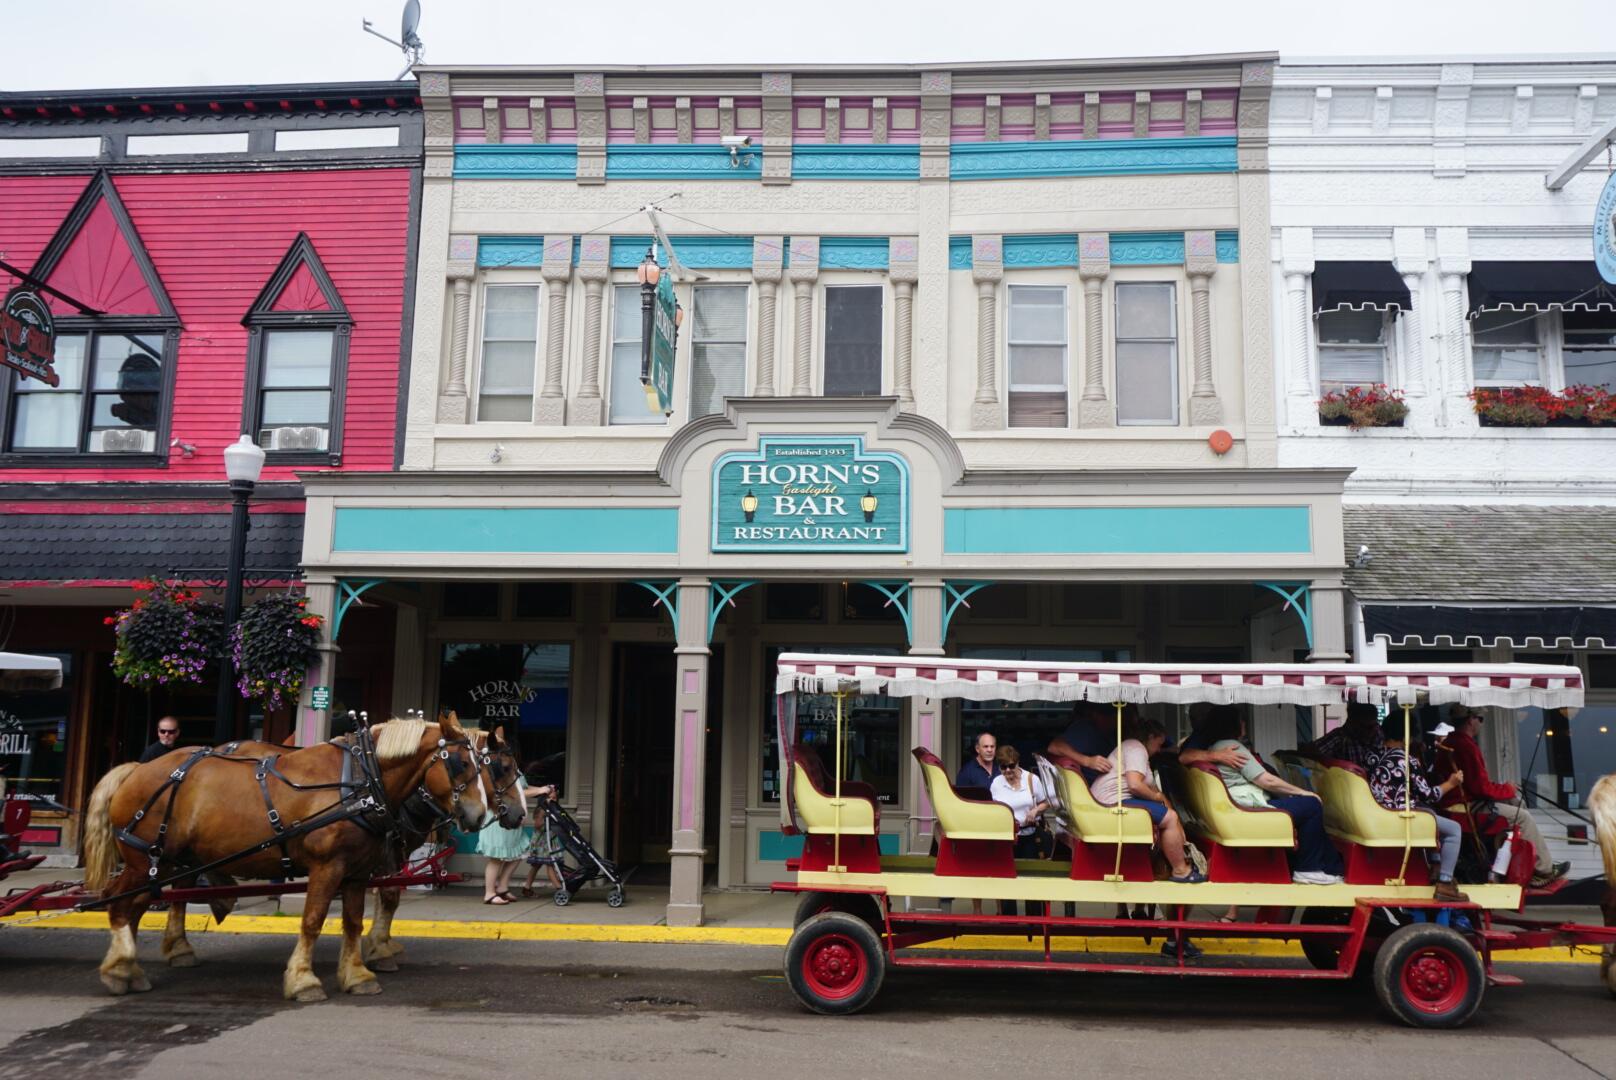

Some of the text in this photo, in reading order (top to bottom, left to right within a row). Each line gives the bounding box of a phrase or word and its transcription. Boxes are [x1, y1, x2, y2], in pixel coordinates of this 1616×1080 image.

[775, 448, 822, 456] Established
[740, 464, 880, 485] HORN'S
[782, 483, 838, 496] Gaslight
[773, 495, 849, 516] BAR
[803, 516, 816, 525] &
[734, 527, 887, 540] RESTAURANT
[468, 680, 538, 703] HORN'S
[485, 704, 520, 717] BAR
[0, 733, 31, 755] RILL
